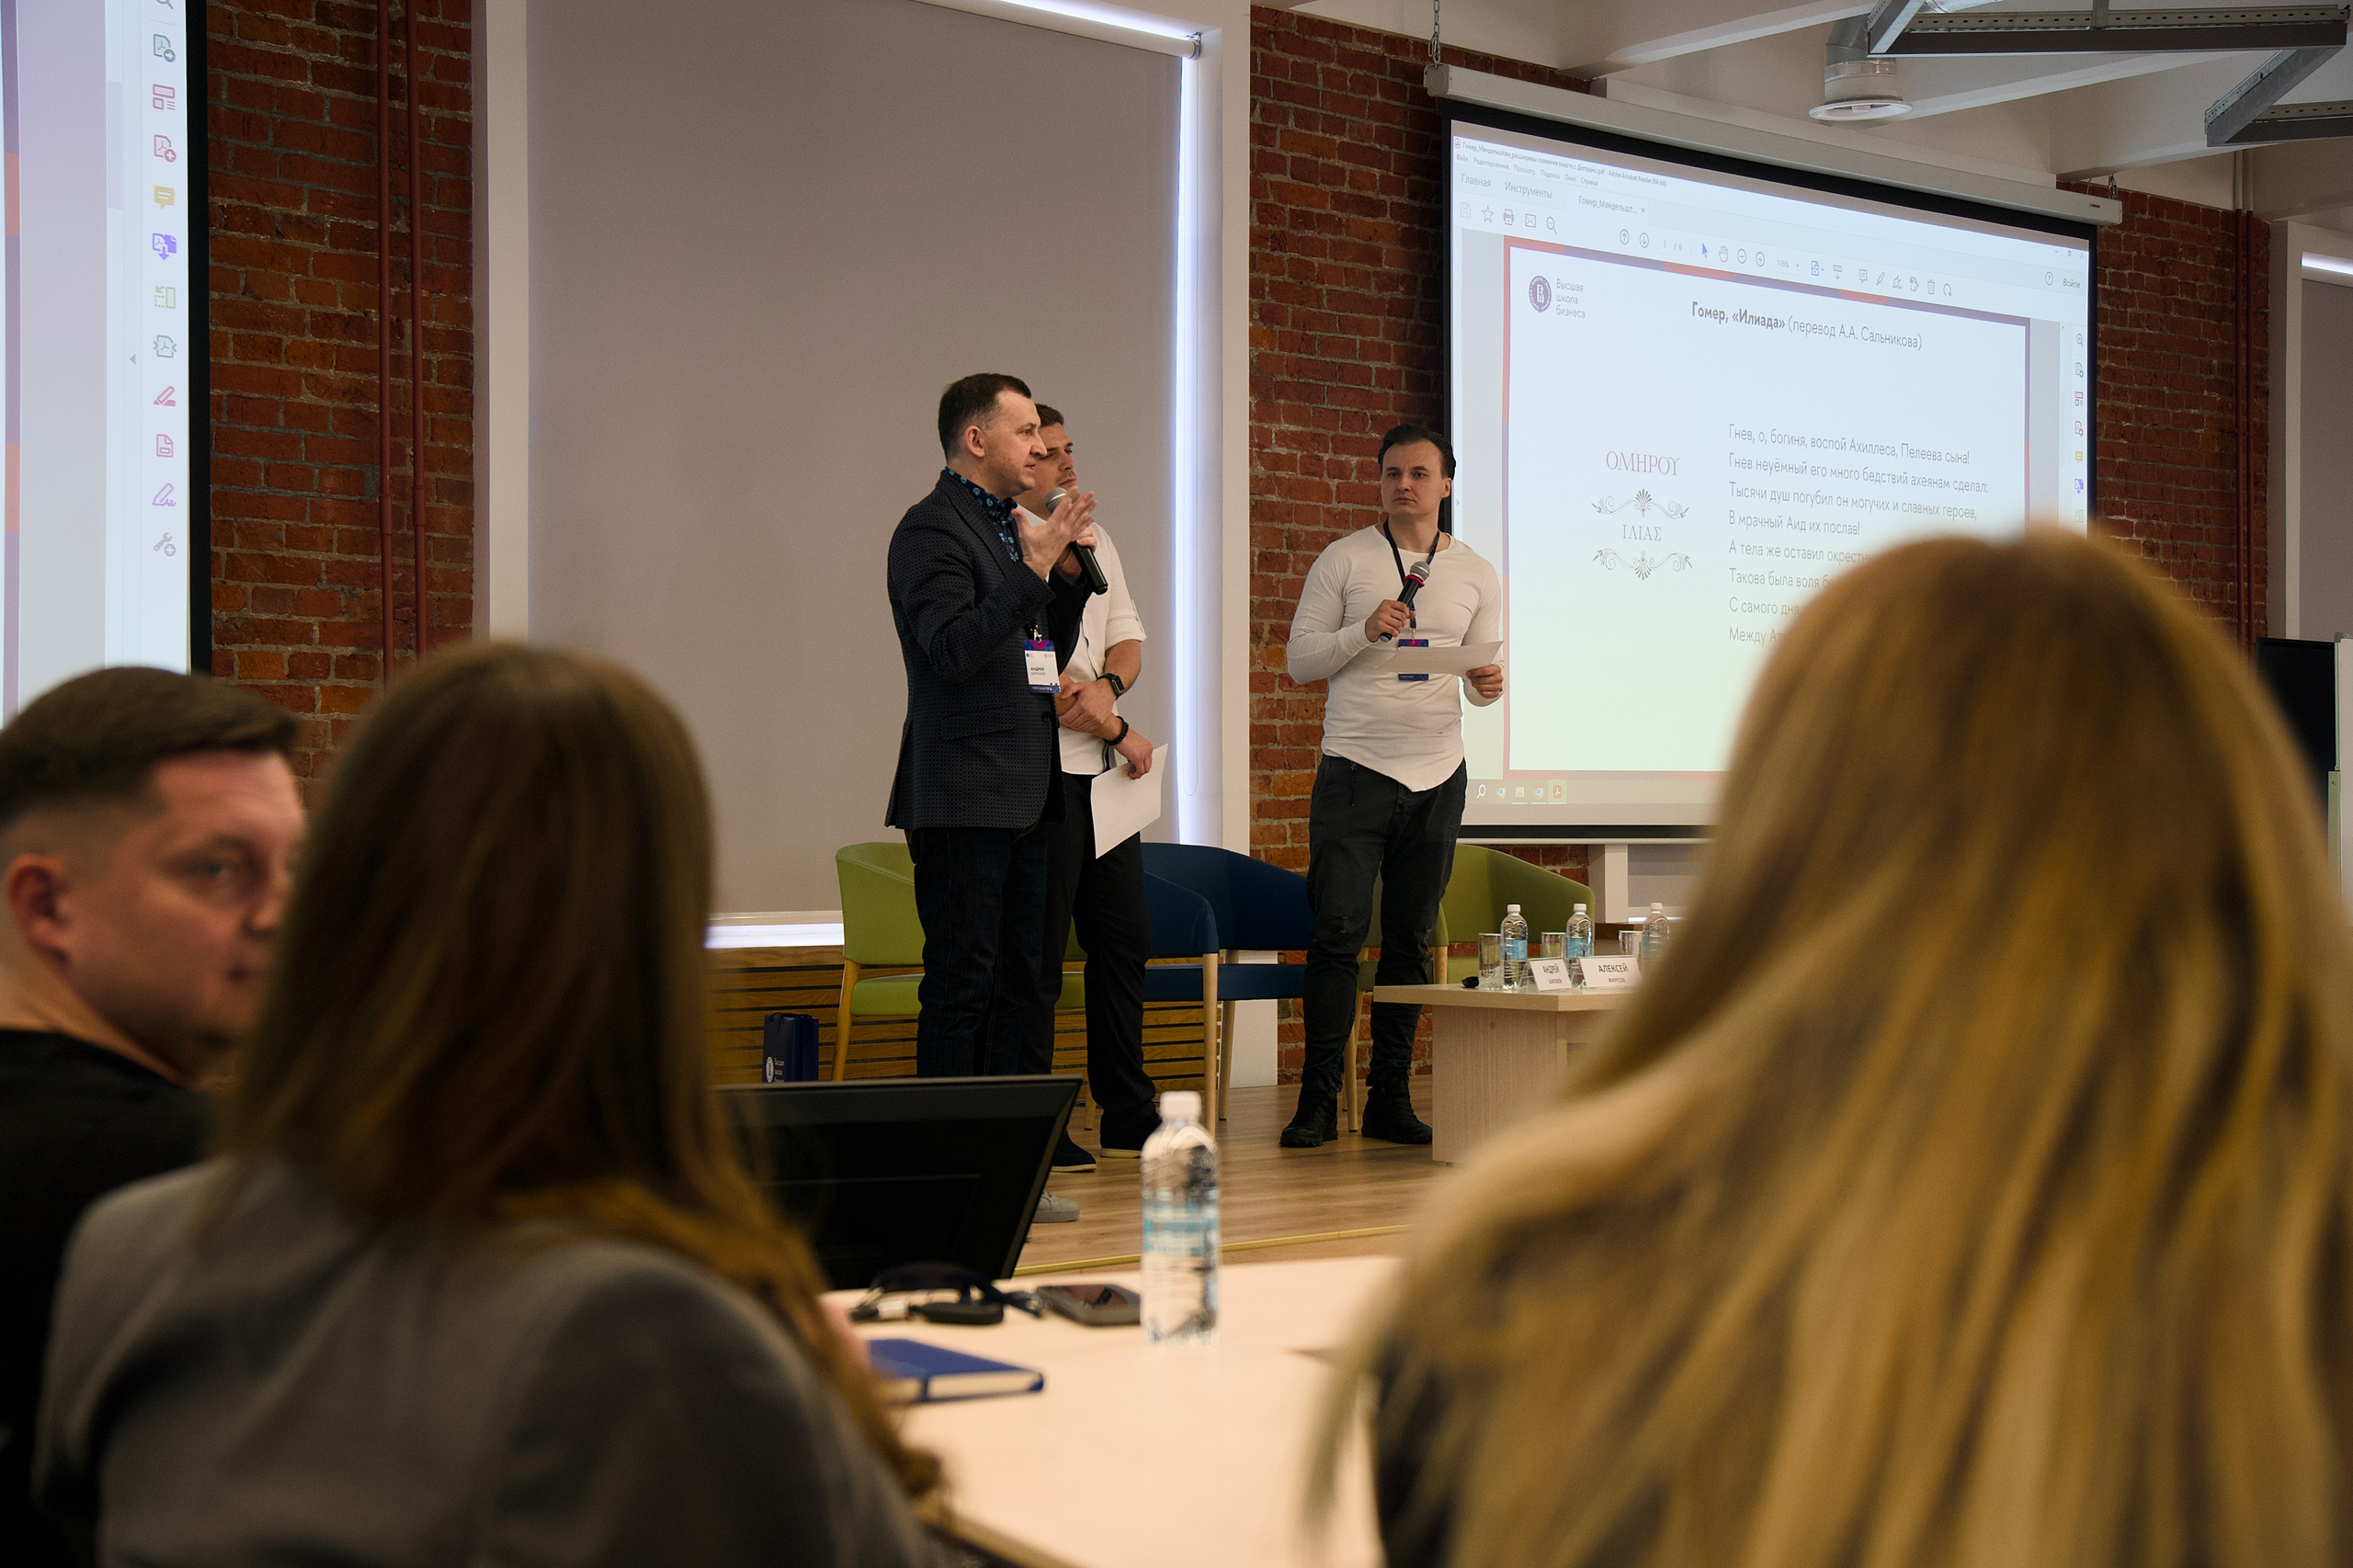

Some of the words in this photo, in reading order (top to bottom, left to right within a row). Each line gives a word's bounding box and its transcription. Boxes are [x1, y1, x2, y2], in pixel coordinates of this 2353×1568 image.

[1473, 156, 1509, 169] Редактирование
[1514, 164, 1536, 176] Просмотр
[1540, 169, 1560, 179] Подпись
[1564, 174, 1576, 182] Окно
[1580, 176, 1598, 186] Справка
[1461, 173, 1491, 187] Главная
[1505, 181, 1552, 199] Инструменты
[1663, 240, 1666, 248] 2
[1777, 258, 1790, 268] 116%
[1556, 278, 1584, 291] Высшая
[2063, 278, 2081, 289] Войти
[1556, 294, 1578, 304] школа
[1556, 304, 1586, 318] бизнеса
[1691, 301, 1729, 324] Гомер,
[1732, 308, 1786, 329] «Илиада»
[1788, 315, 1836, 339] (перевод
[1838, 323, 1859, 340] А.А.
[1860, 325, 1923, 351] Сальникова)
[1729, 424, 1756, 444] Гнев,
[1757, 431, 1768, 445] о,
[1770, 428, 1808, 449] богиня,
[1811, 437, 1847, 451] воспой
[1849, 437, 1899, 459] Ахиллеса,
[1901, 442, 1942, 461] Пелеева
[1945, 450, 1971, 464] сына!
[1729, 452, 1753, 470] Гнев
[1756, 458, 1808, 476] неуёмный
[1810, 465, 1828, 479] его
[1830, 467, 1860, 481] много
[1862, 466, 1908, 485] бедствий
[1911, 474, 1950, 489] ахеянам
[1952, 480, 1988, 494] сделал:
[1729, 481, 1768, 499] Тысячи
[1770, 490, 1790, 505] душ
[1792, 489, 1834, 508] погубил
[1836, 495, 1848, 506] он
[1851, 498, 1891, 513] могучих
[1893, 500, 1899, 511] и
[1901, 502, 1941, 516] славных
[1942, 506, 1978, 521] героев,
[1729, 509, 1735, 525] В
[1738, 515, 1784, 530] мрачный
[1786, 516, 1807, 534] Аид
[1809, 521, 1821, 532] их
[1824, 520, 1860, 536] послав!
[1729, 540, 1737, 553] А
[1740, 543, 1765, 557] тела
[1767, 546, 1781, 558] же
[1784, 547, 1824, 561] оставил
[1729, 567, 1766, 585] Такова
[1768, 570, 1793, 586] была
[1796, 578, 1820, 588] воля
[1729, 597, 1738, 612] С
[1741, 601, 1778, 615] самого
[1729, 626, 1767, 644] Между
[1542, 963, 1560, 975] АНДРЕЙ
[1598, 962, 1629, 973] АЛЕКСЕЙ
